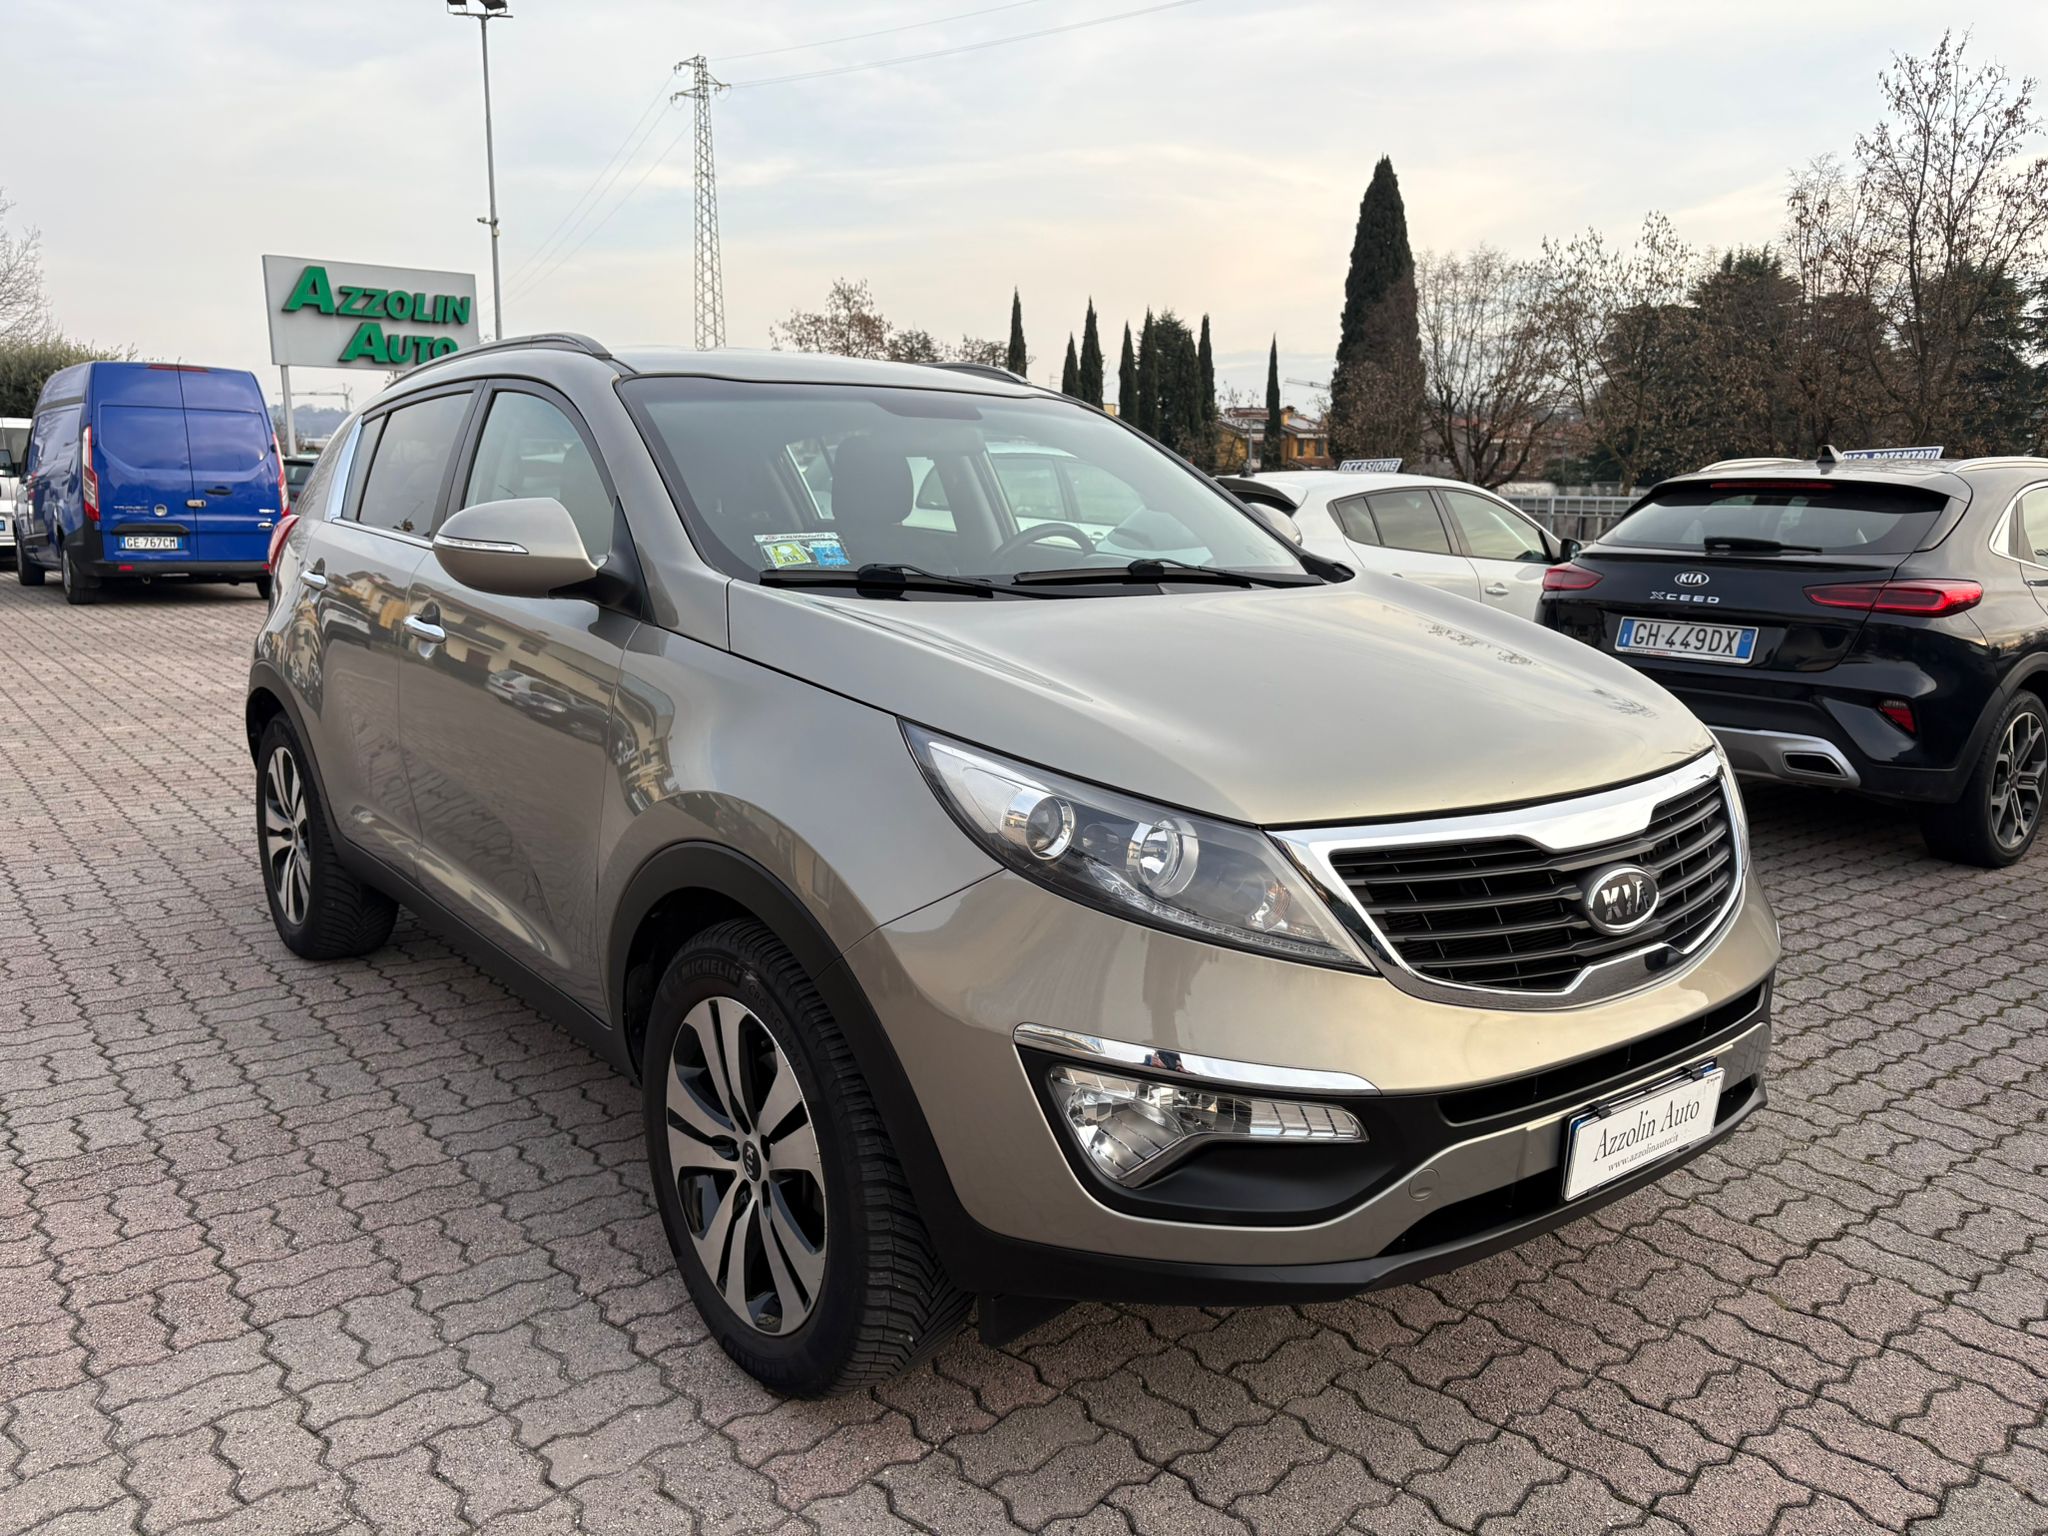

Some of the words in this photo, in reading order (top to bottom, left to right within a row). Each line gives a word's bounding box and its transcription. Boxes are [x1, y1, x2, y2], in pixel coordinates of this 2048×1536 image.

[282, 265, 471, 325] AZZOLIN
[338, 322, 458, 364] AUTO
[1343, 461, 1398, 473] OCCASIONE
[1649, 591, 1720, 604] XCEED
[1679, 573, 1703, 584] KIA
[1601, 880, 1650, 921] KIA
[681, 959, 741, 985] MICHELIN
[1594, 1109, 1657, 1162] Azzolin
[1660, 1099, 1700, 1133] Auto
[1608, 1132, 1679, 1171] www.azzolinauto.it
